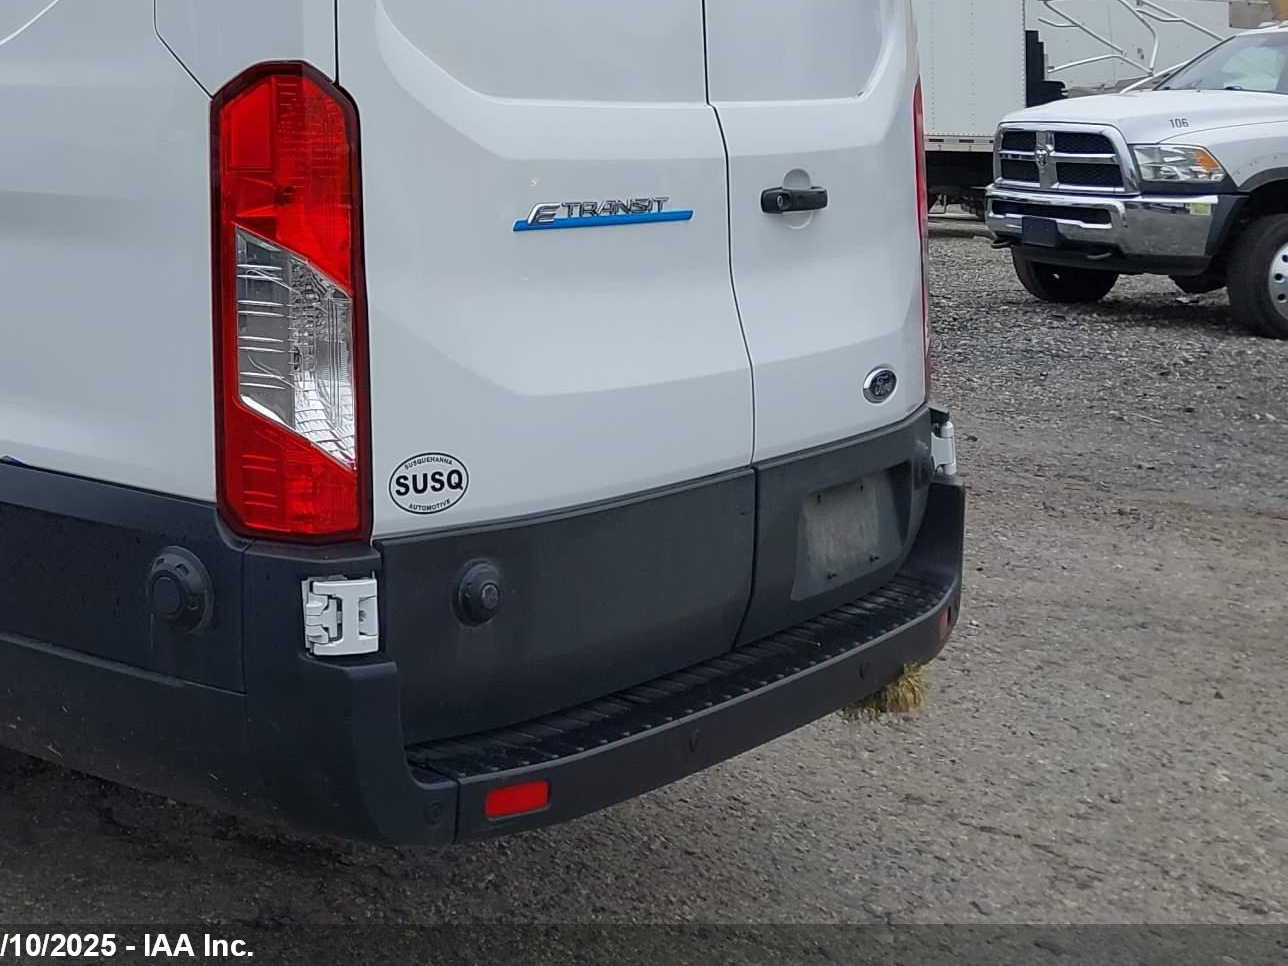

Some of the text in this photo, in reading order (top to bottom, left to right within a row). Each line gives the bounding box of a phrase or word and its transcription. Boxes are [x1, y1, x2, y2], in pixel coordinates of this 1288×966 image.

[1168, 118, 1189, 129] 106
[404, 456, 453, 471] SUSQUEHANNA
[395, 469, 463, 496] SUSQ
[408, 498, 451, 511] AUTOMOTIVE
